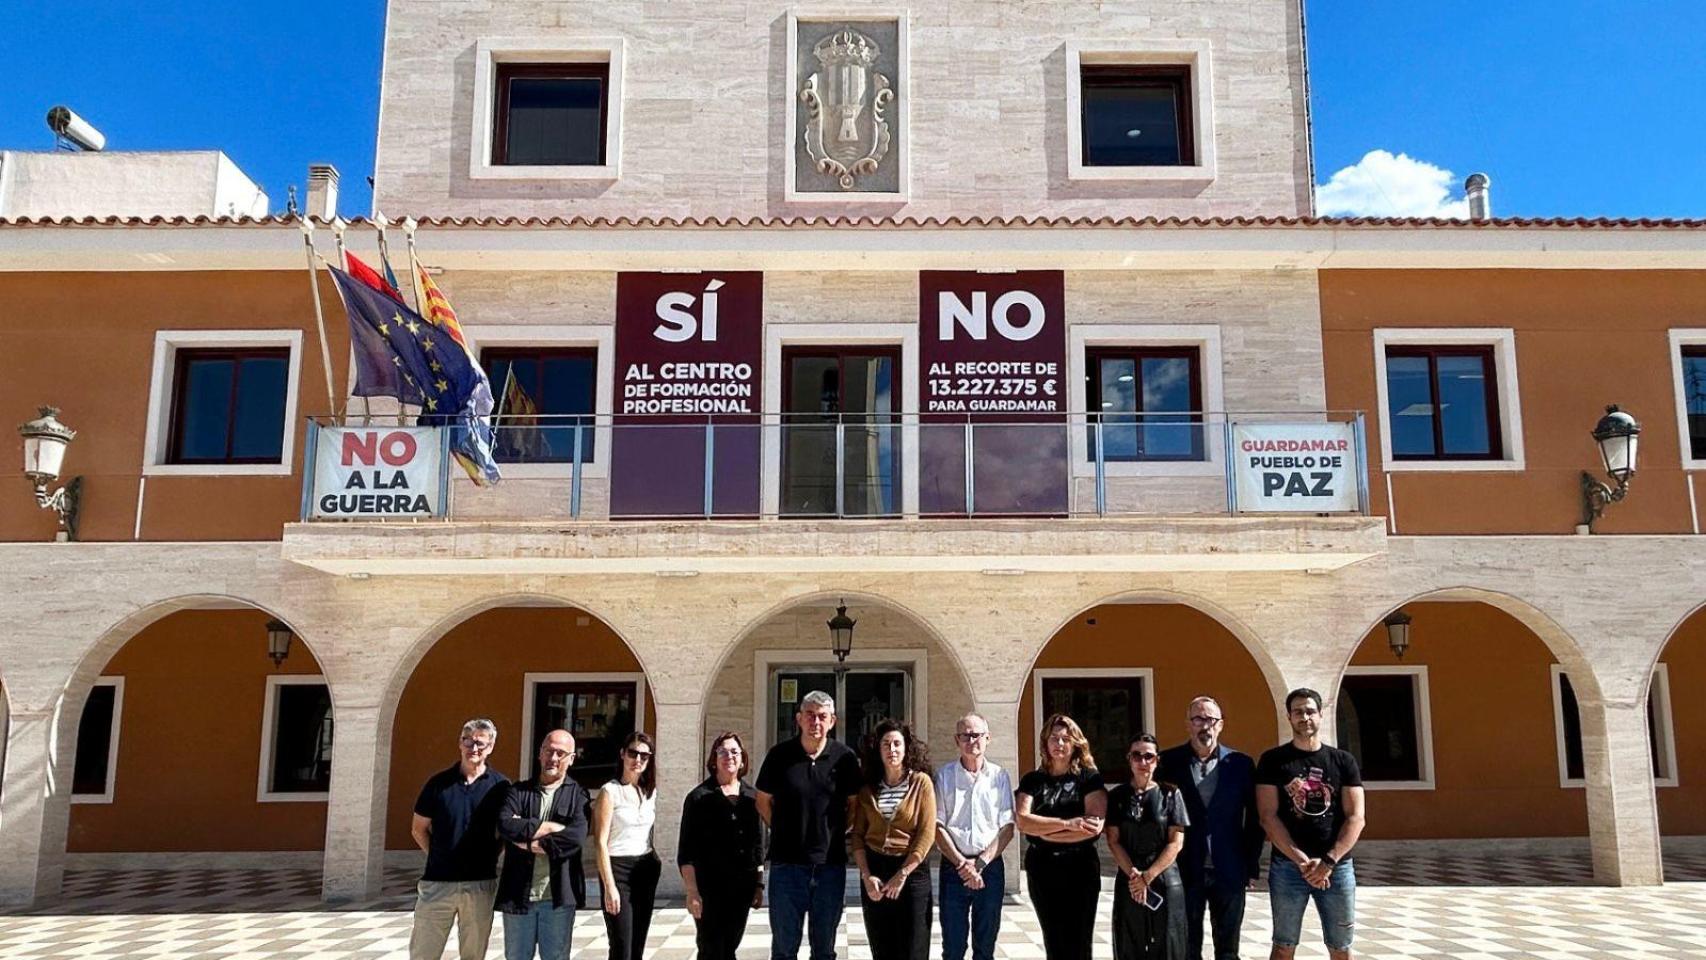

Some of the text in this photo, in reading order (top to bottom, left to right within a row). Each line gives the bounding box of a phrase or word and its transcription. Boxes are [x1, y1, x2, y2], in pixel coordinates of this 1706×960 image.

[653, 278, 726, 342] SÍ
[938, 290, 1046, 341] NO
[625, 362, 752, 380] AL CENTRO
[929, 362, 1057, 375] AL RECORTE DE
[624, 380, 751, 398] DE FORMACIÓN
[929, 378, 1057, 395] 13.227.375 €
[623, 398, 751, 414] PROFESIONAL
[929, 399, 1057, 411] PARA GUARDAMAR
[341, 431, 417, 466] NO
[1241, 440, 1348, 452] GUARDAMAR
[1250, 456, 1342, 468] PUEBLO DE
[345, 470, 410, 490] A LA
[1262, 472, 1334, 497] PAZ
[320, 494, 432, 514] GUERRA
